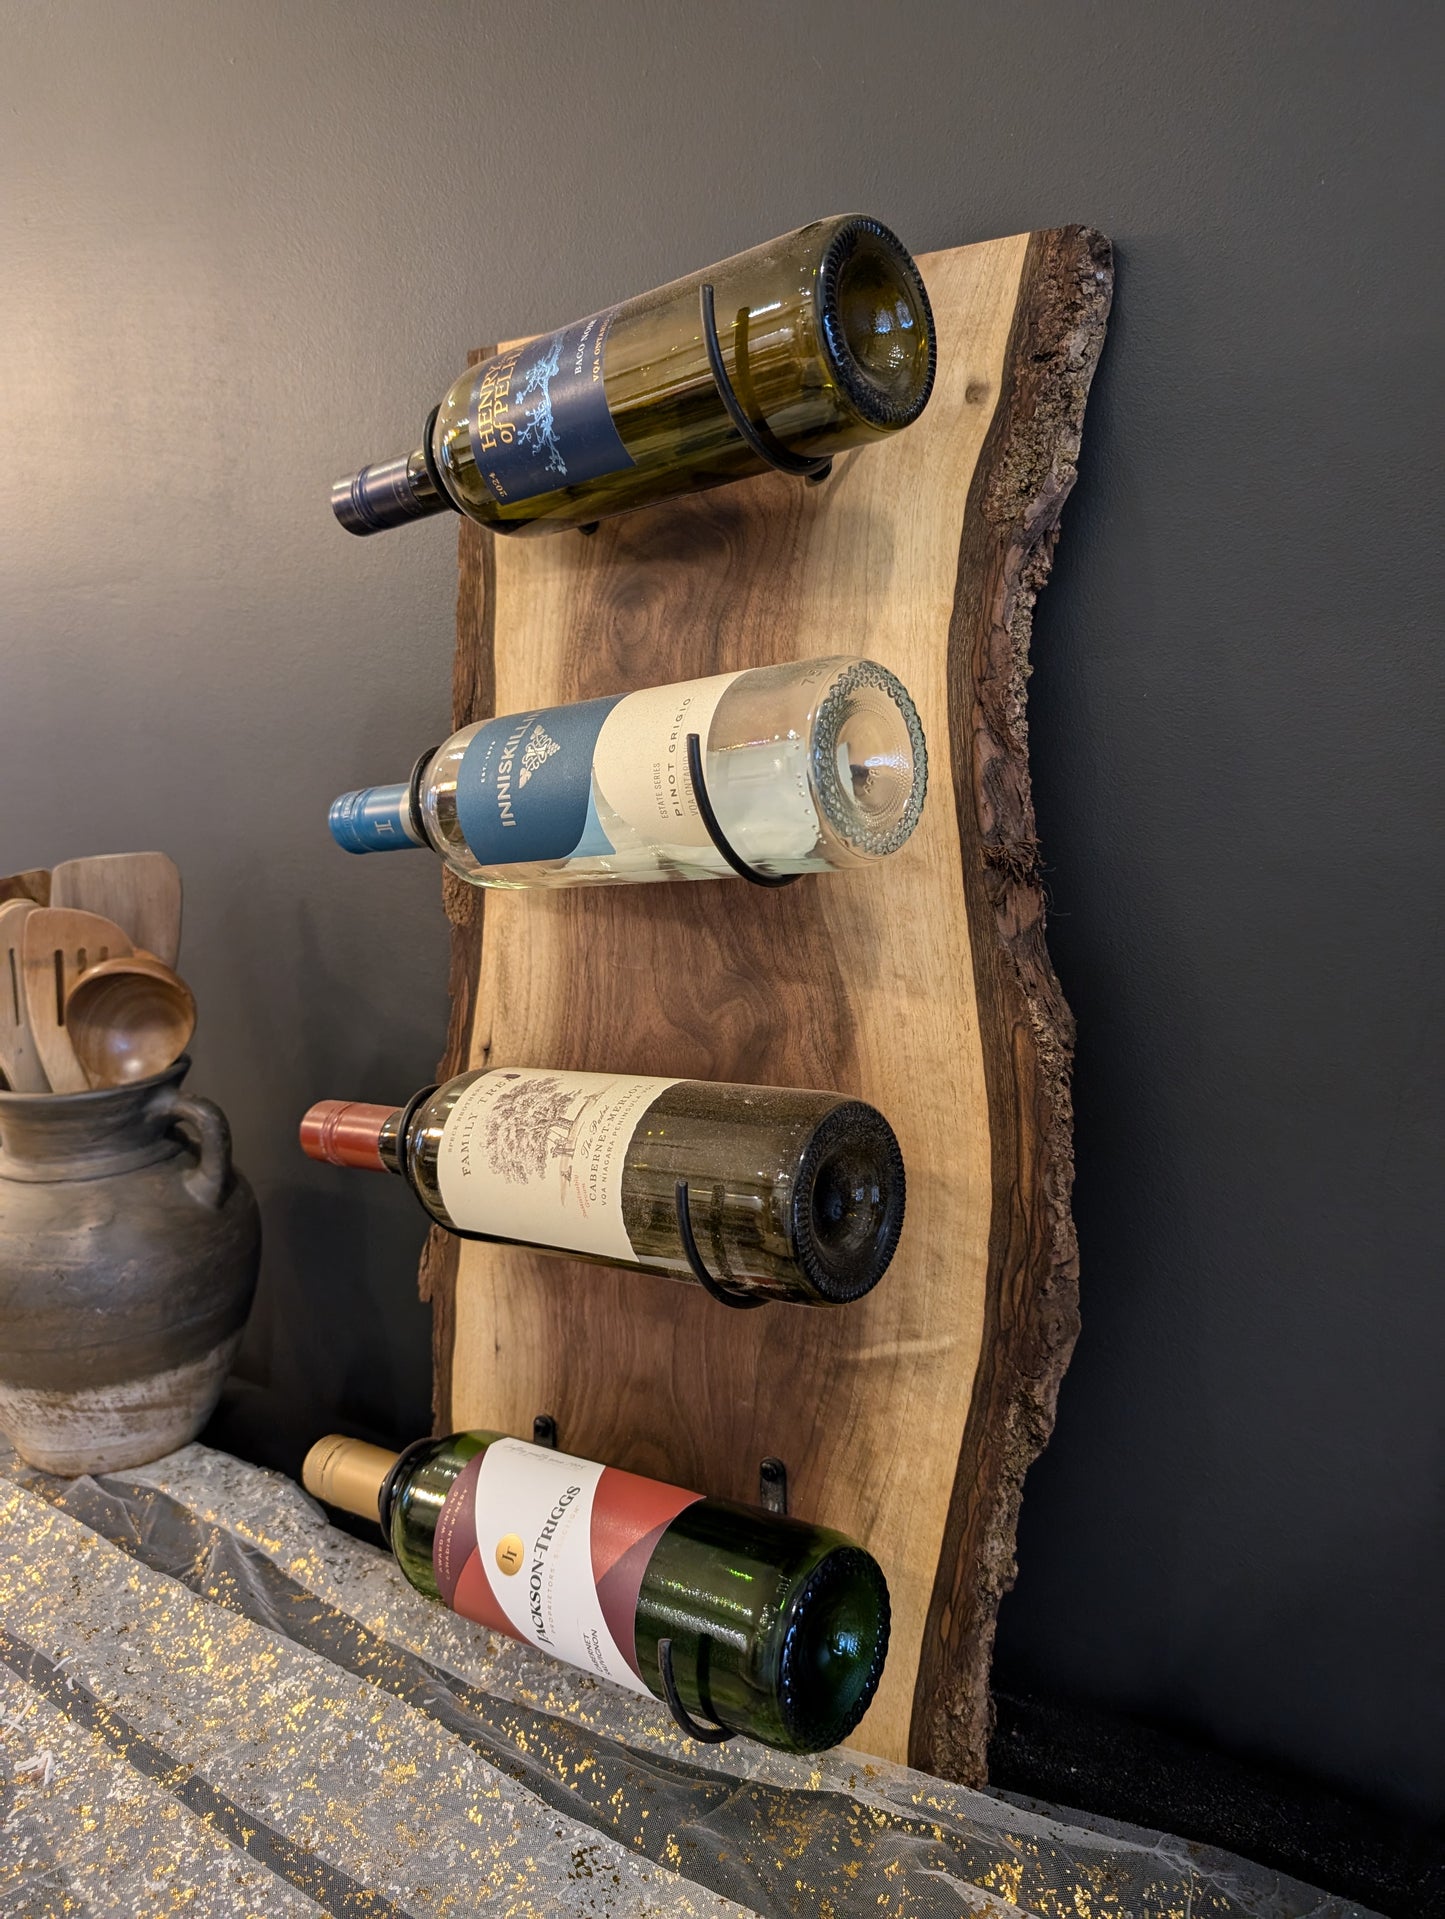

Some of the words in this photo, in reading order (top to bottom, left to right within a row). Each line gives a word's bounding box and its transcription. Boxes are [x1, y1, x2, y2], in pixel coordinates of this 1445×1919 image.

[574, 343, 585, 375] BACO
[592, 359, 600, 382] VQA
[478, 365, 501, 452] HENRY
[493, 418, 515, 444] of
[668, 697, 691, 753] GRIGIO
[653, 762, 663, 790] SERIES
[668, 763, 683, 816] PINOT
[655, 786, 669, 819] ESTATE
[461, 1112, 478, 1176] FAMILY
[589, 1084, 643, 1202] CABERNET-MERLOT
[602, 1140, 615, 1182] NIAGARA
[612, 1096, 641, 1137] PENINSULA
[441, 1490, 459, 1534] WINNING
[529, 1485, 581, 1647] JACKSON-TRIGGS
[583, 1632, 604, 1673] CABERNET
